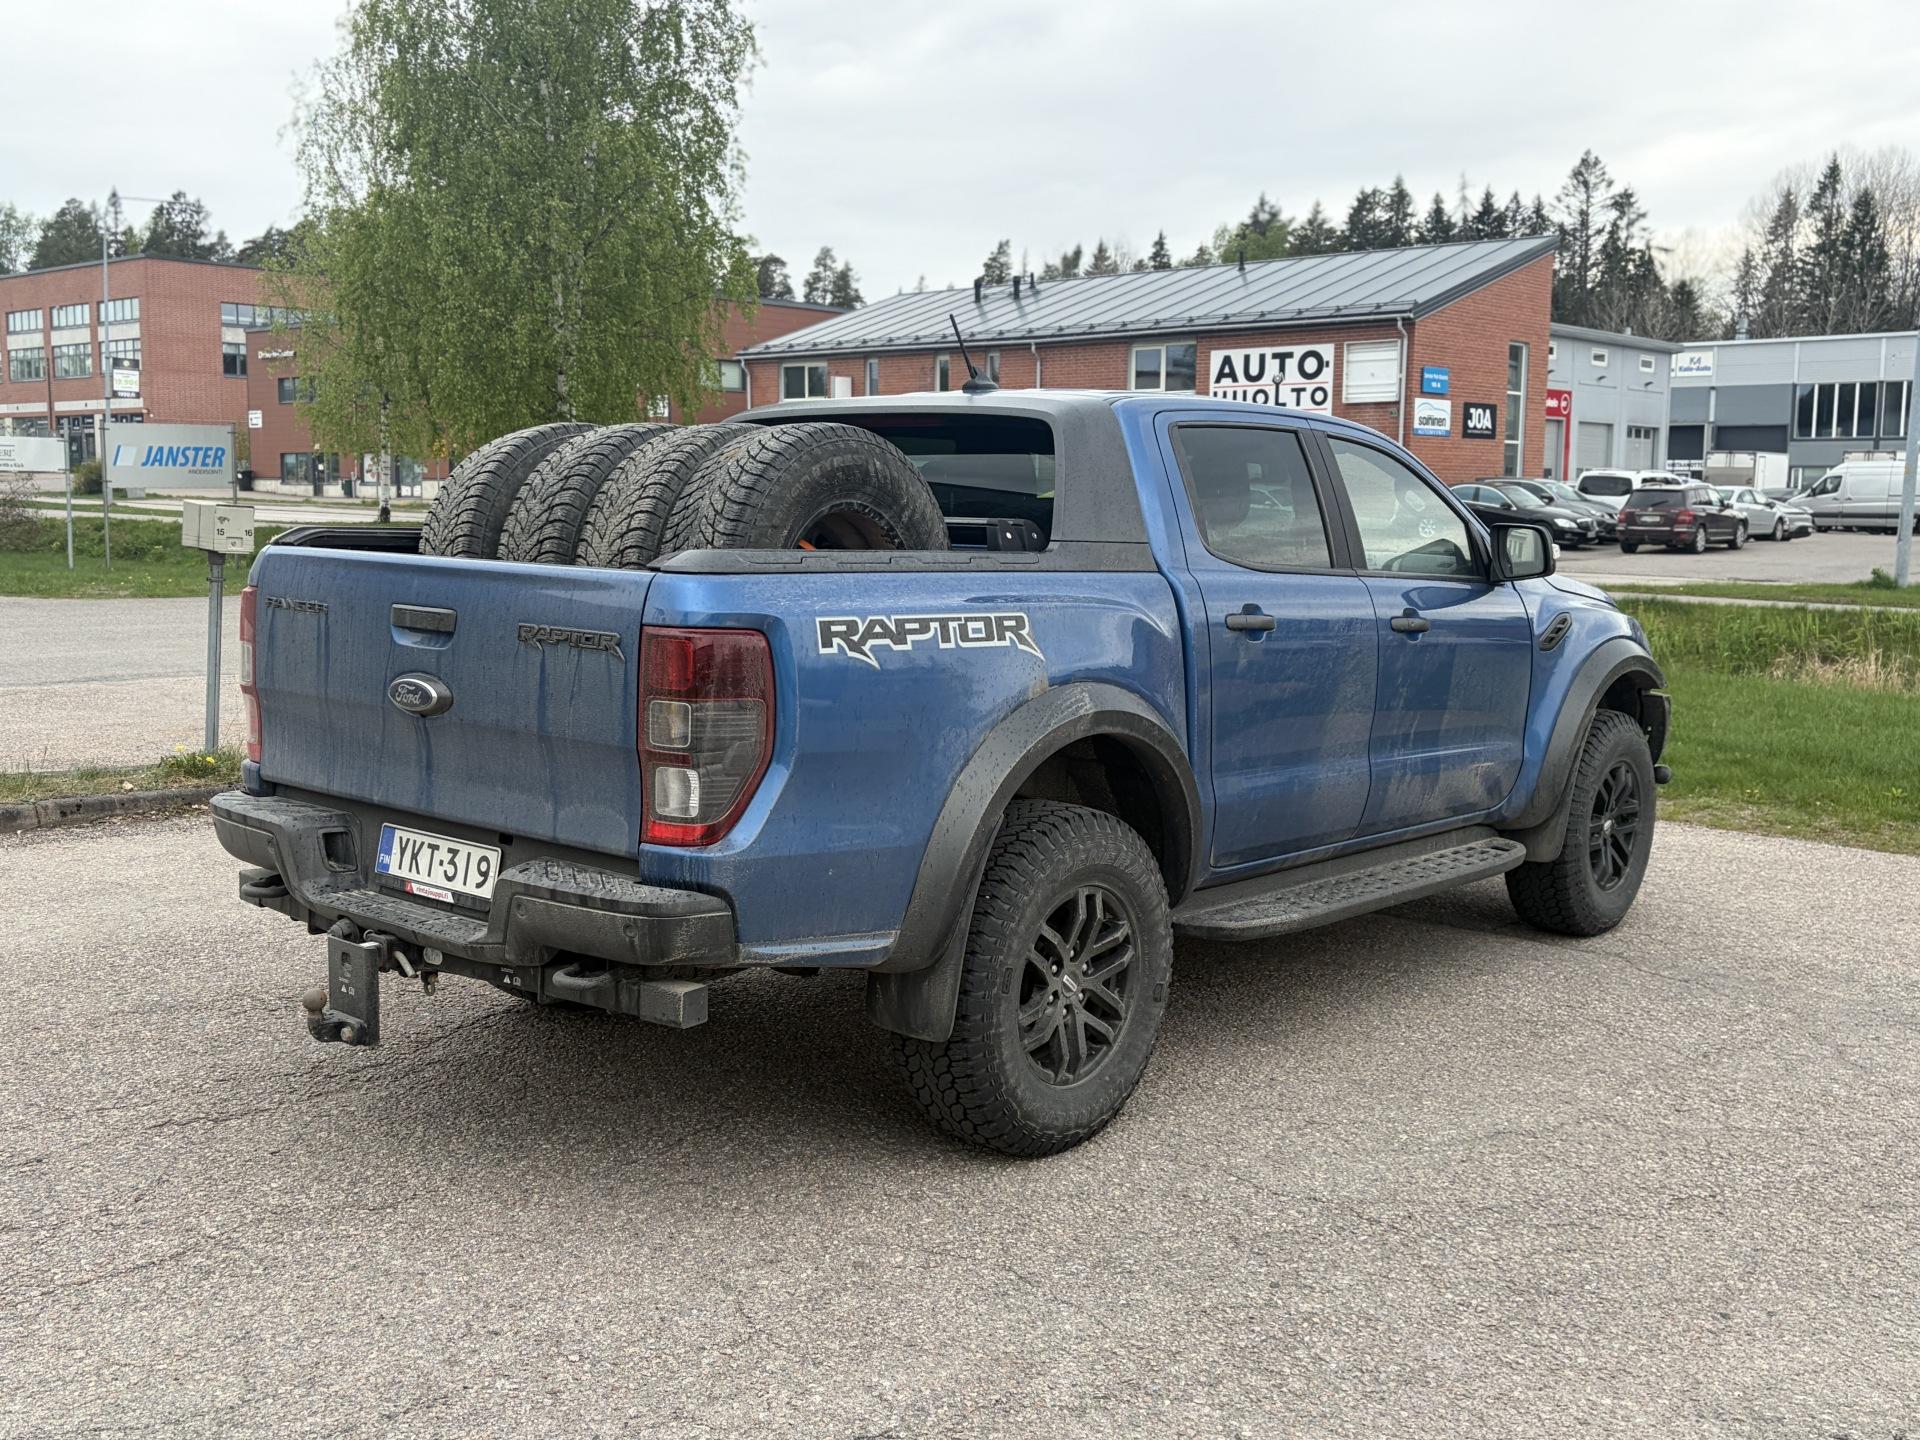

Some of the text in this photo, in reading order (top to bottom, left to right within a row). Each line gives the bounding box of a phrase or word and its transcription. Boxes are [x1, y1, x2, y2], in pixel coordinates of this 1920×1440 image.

[1467, 407, 1492, 430] JOA
[141, 445, 226, 468] JANSTER
[216, 528, 225, 536] 15
[244, 529, 253, 537] 16
[517, 622, 625, 661] RAPTOR
[815, 611, 1046, 671] RAPTOR
[395, 683, 422, 705] Ford
[379, 853, 391, 865] FIN
[398, 835, 491, 889] YKT-319
